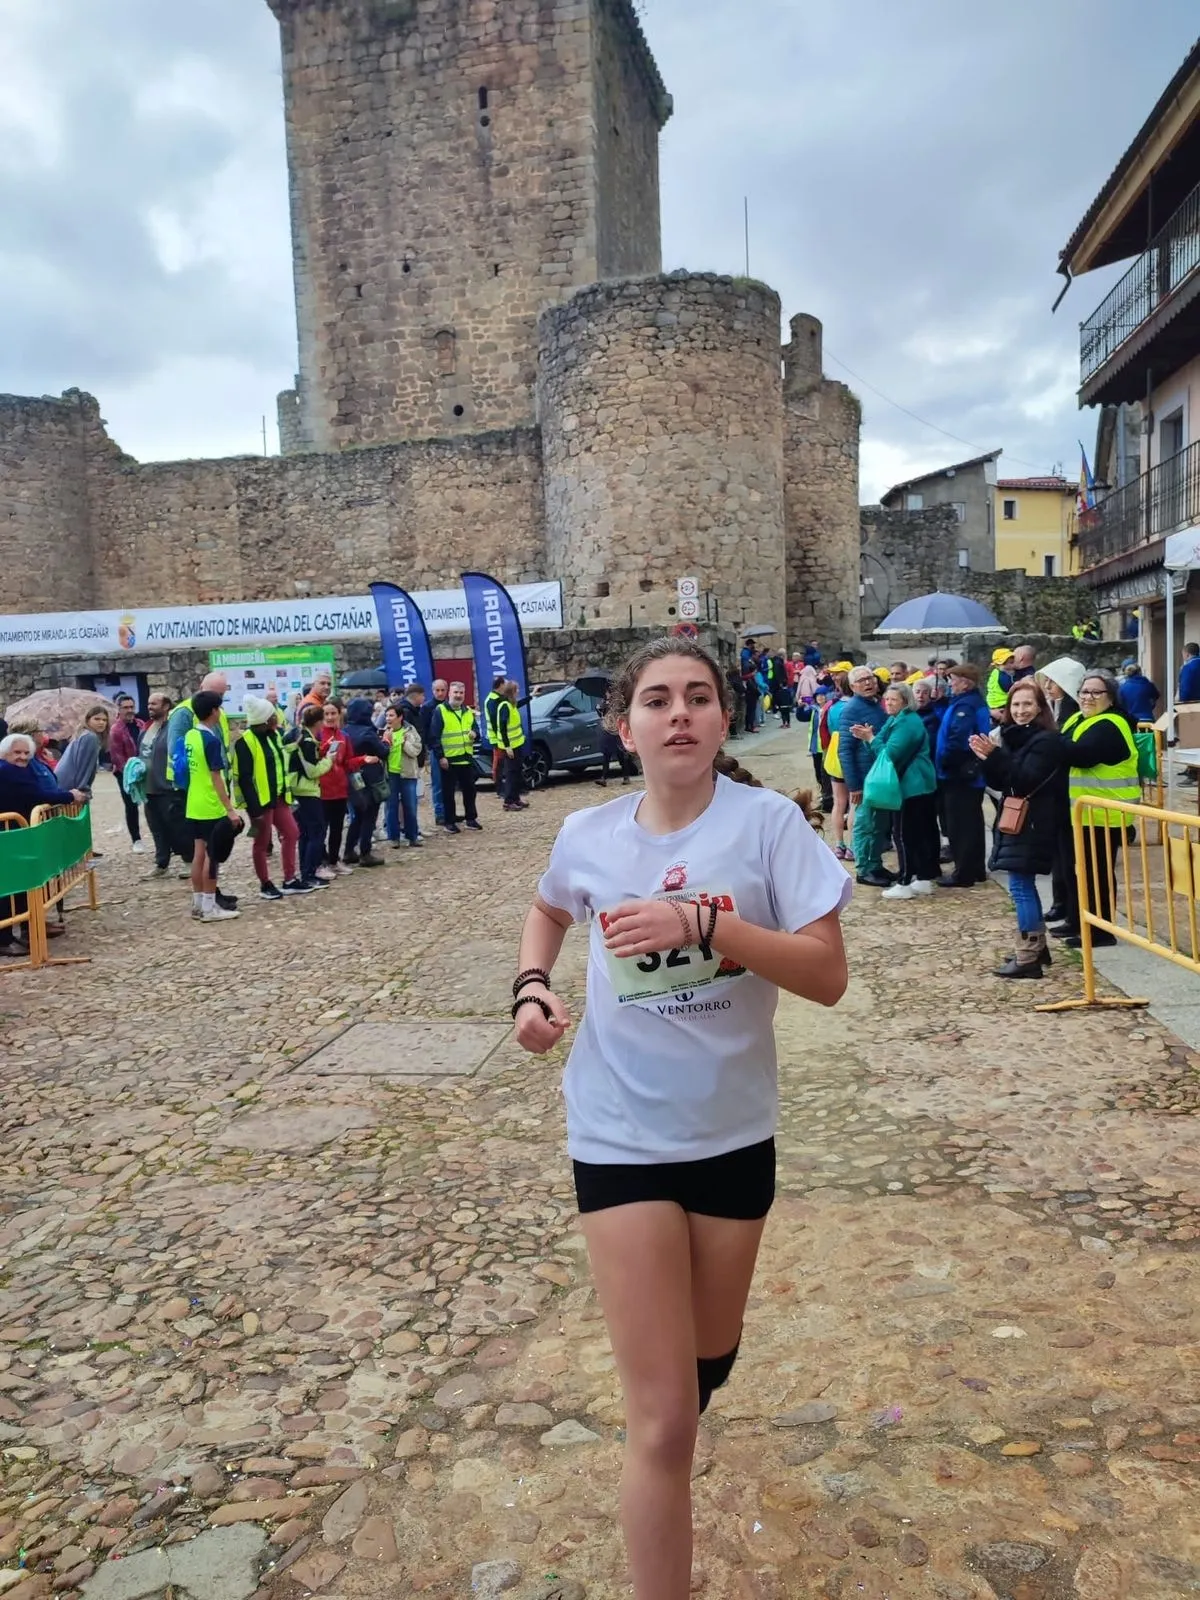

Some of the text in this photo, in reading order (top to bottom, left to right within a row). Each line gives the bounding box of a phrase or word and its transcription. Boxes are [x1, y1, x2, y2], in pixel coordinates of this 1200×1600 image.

[146, 606, 372, 639] AYUNTAMIENTO DE MIRANDA DEL CASTAÑAR
[657, 1000, 731, 1016] VENTORRO
